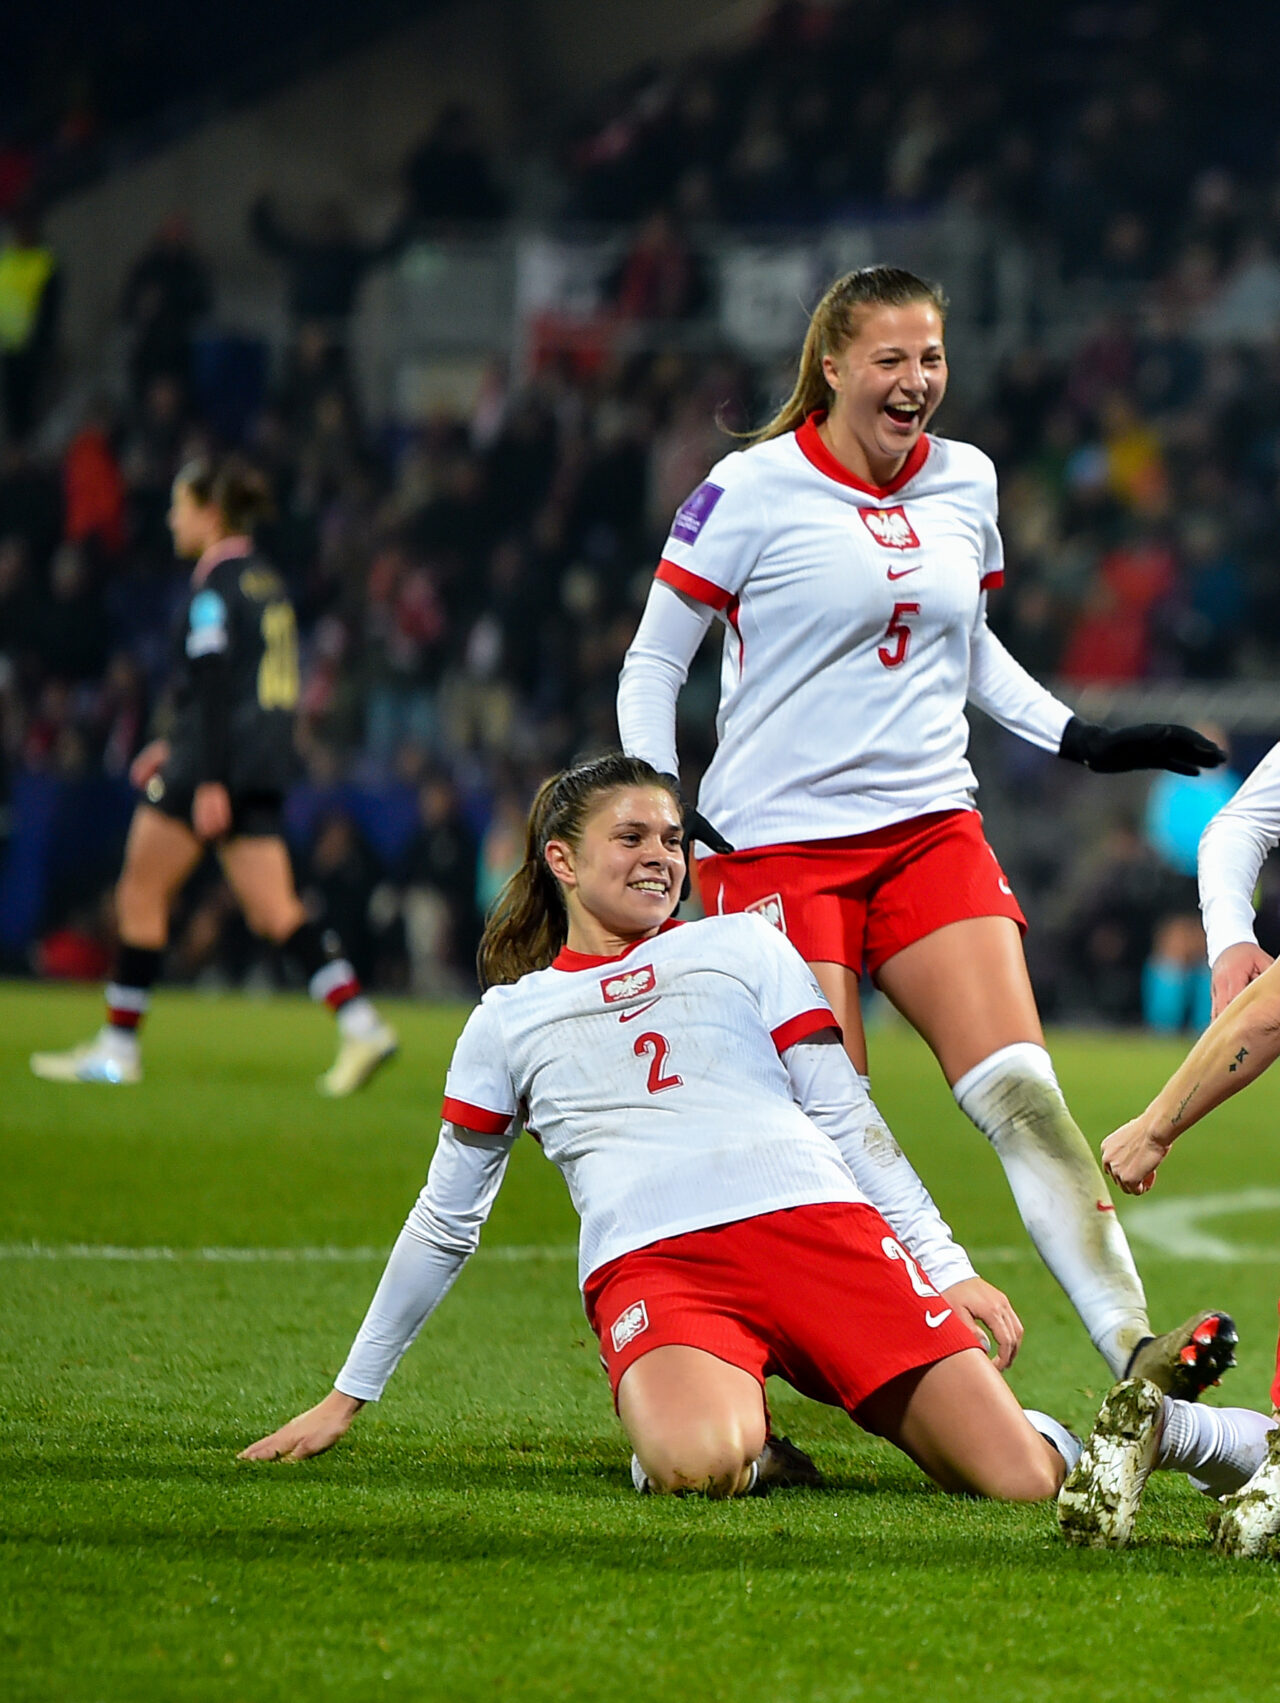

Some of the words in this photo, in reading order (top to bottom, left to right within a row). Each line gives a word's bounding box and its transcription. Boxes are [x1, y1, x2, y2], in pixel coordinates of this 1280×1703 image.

[877, 602, 921, 671] 5
[633, 1031, 684, 1095] 2
[1235, 1046, 1249, 1064] K
[880, 1235, 941, 1298] 2
